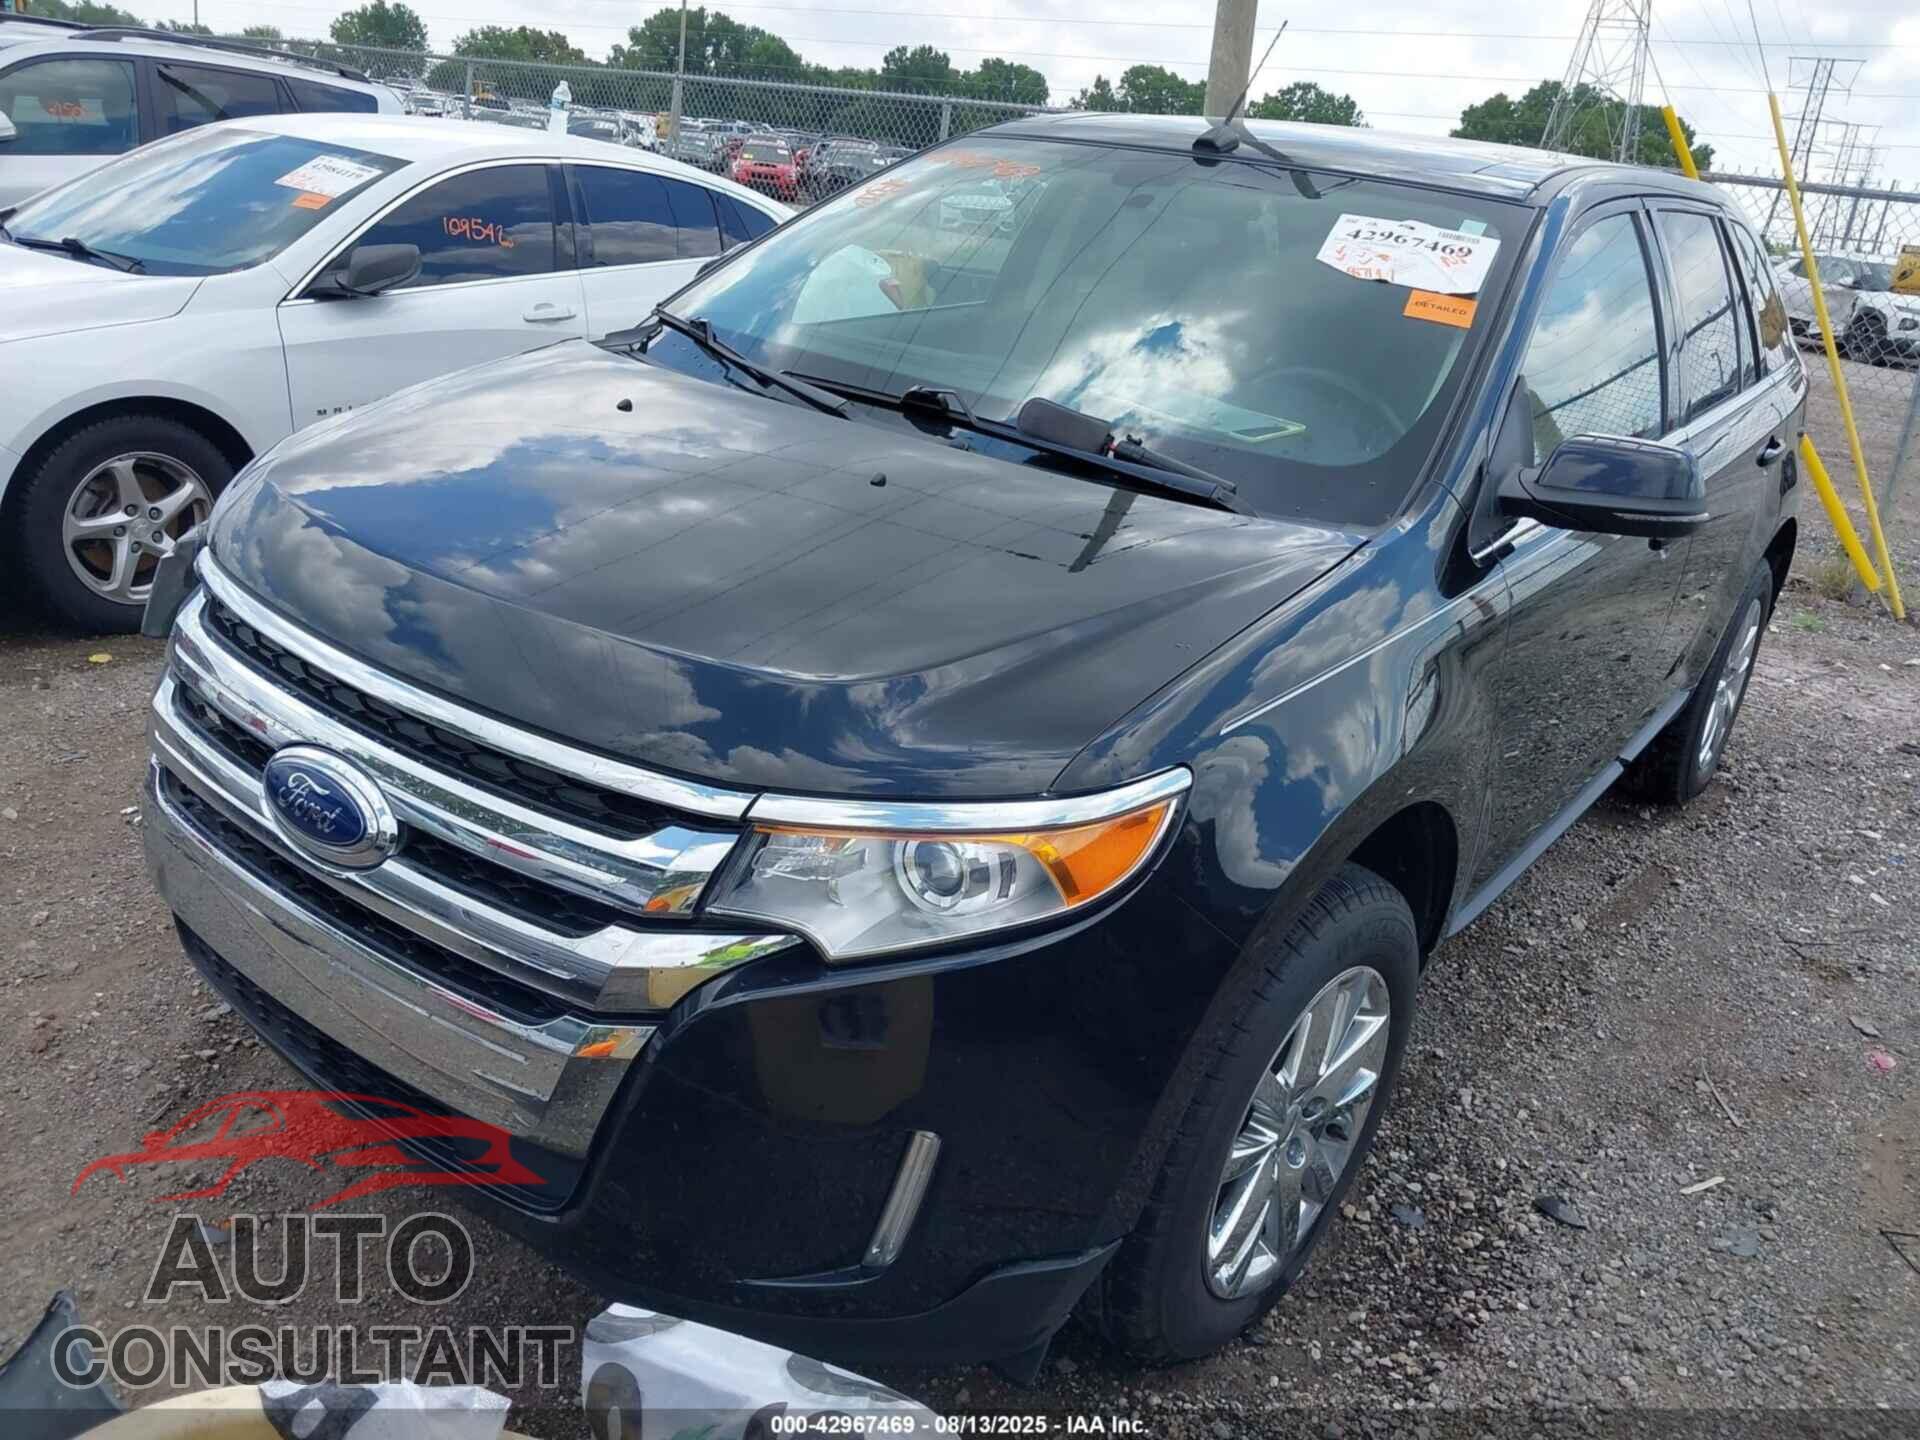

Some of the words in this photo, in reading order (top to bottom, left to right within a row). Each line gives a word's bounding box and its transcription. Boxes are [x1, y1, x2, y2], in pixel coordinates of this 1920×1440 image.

[1346, 228, 1473, 259] 42967469
[1414, 300, 1468, 316] DETAILED
[279, 772, 343, 833] Ford
